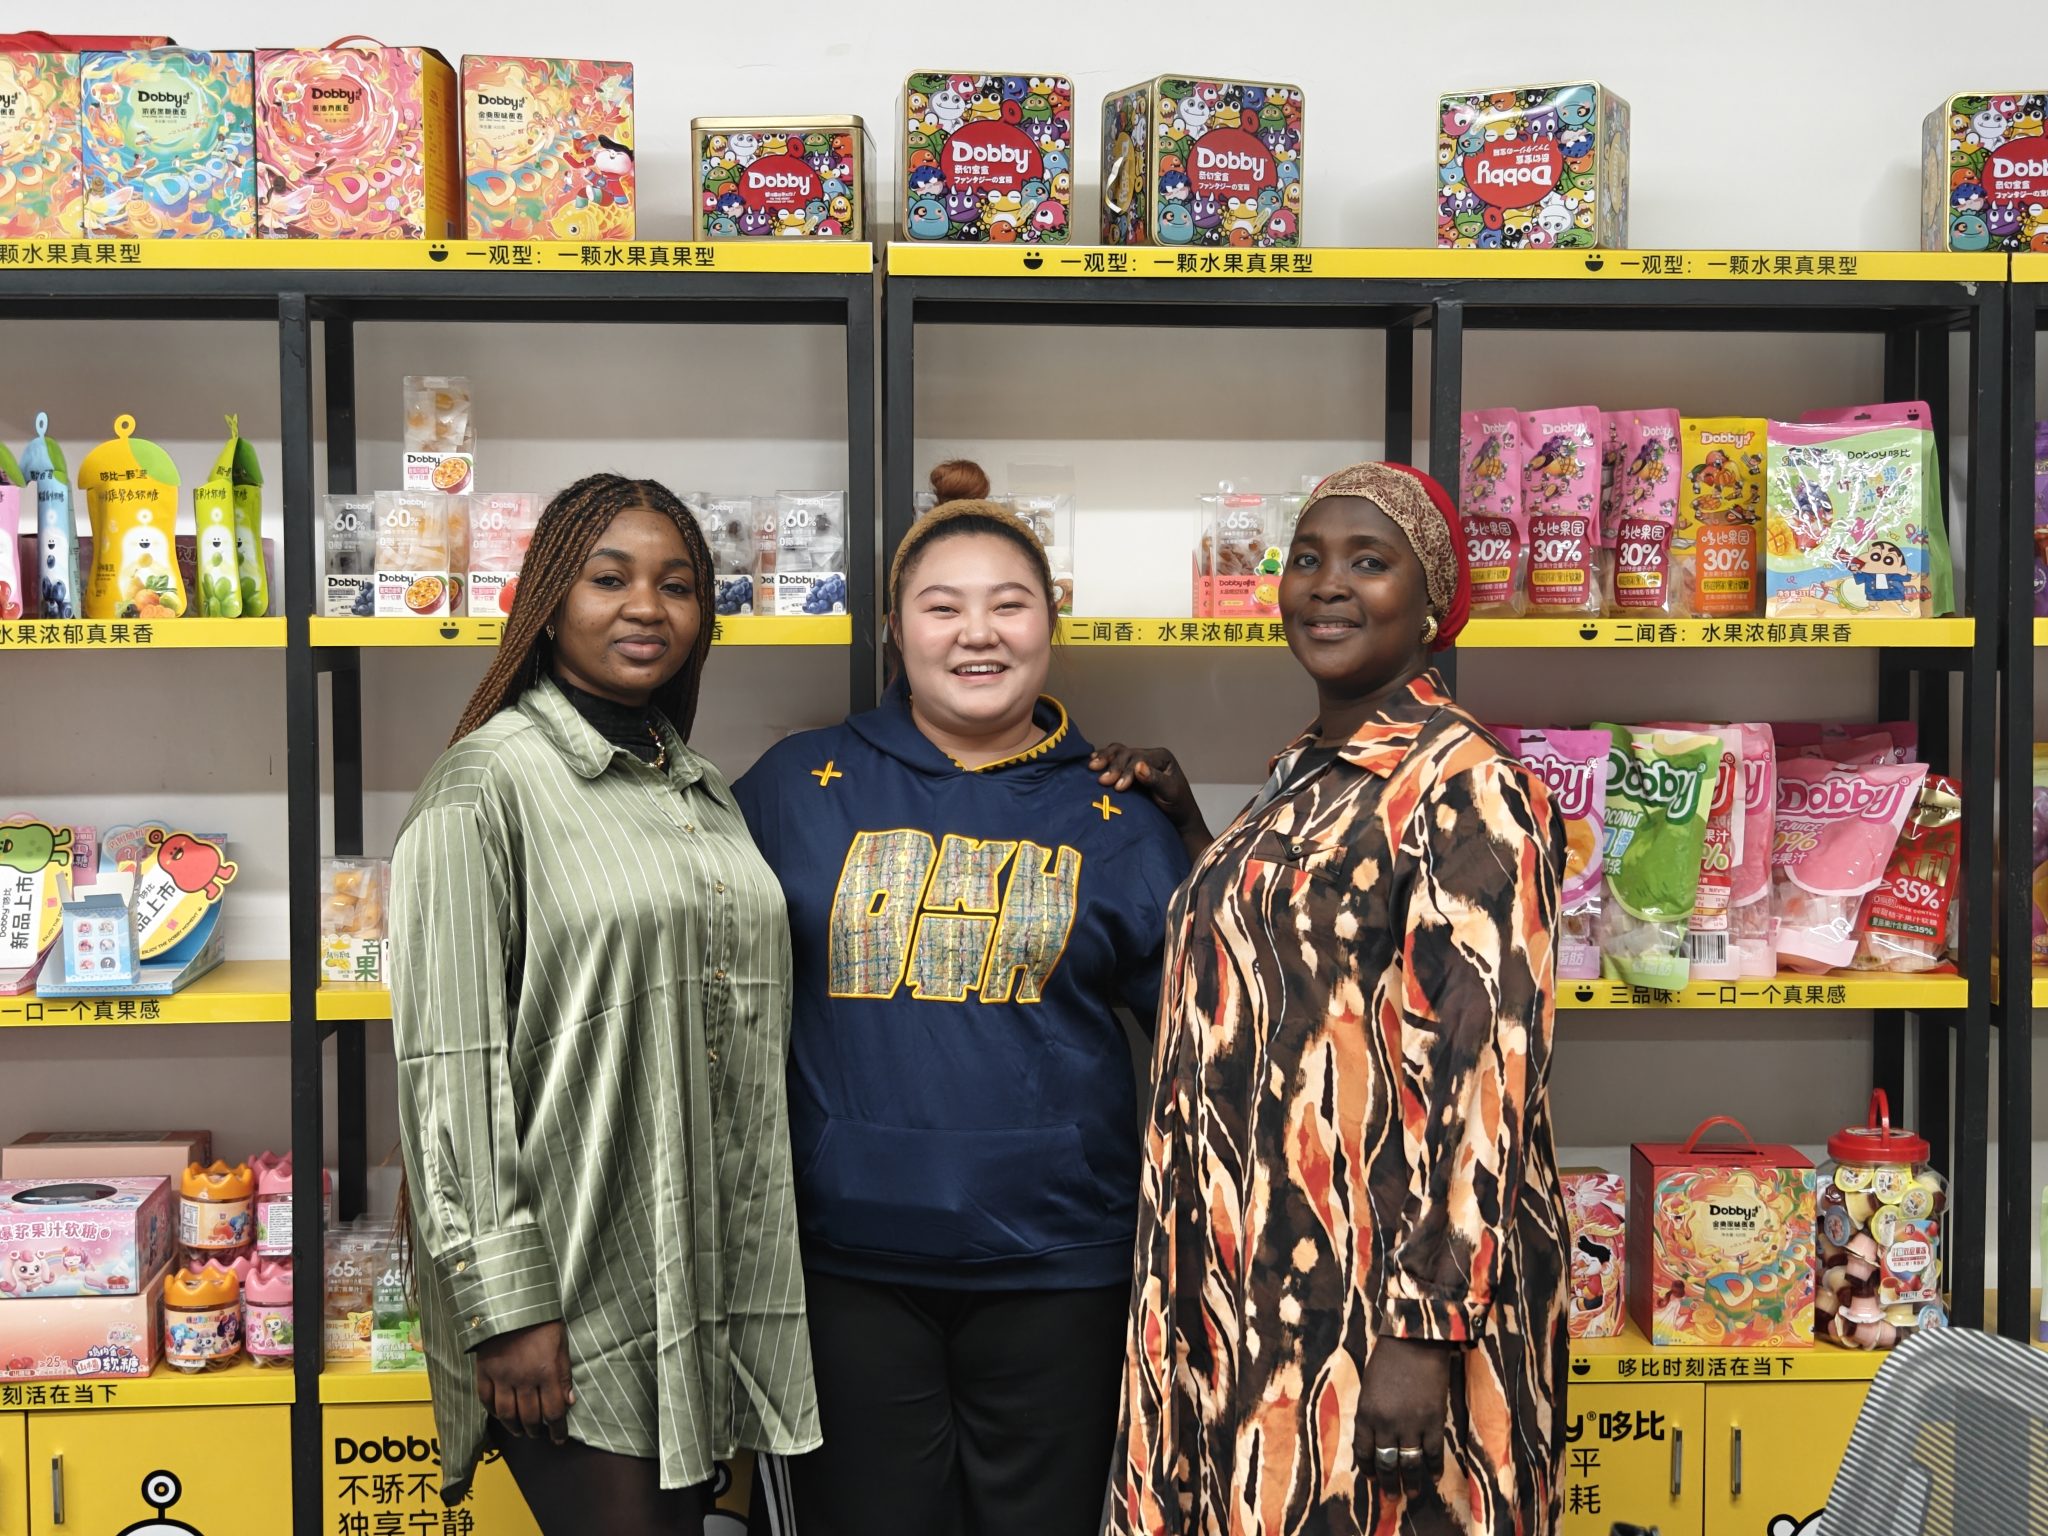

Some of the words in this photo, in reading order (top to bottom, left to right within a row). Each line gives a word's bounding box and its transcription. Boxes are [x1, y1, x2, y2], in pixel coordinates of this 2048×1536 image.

[137, 91, 183, 108] Dobby
[311, 87, 355, 104] Dobby
[478, 94, 519, 111] Dobby
[952, 140, 1030, 173] Dobby
[1196, 146, 1265, 181] Dobby
[748, 172, 811, 196] Dobby
[1476, 160, 1552, 187] Dobby
[557, 245, 716, 268] 一颗水果真果型
[1153, 252, 1313, 274] 一颗水果真果型
[1707, 255, 1858, 276] 一颗水果真果型
[1701, 431, 1745, 449] Dobby
[407, 454, 441, 467] Dobby
[1464, 520, 1512, 537] 哆比果园
[1532, 520, 1585, 537] 哆比果园
[1620, 524, 1665, 540] 哆比果园
[1701, 529, 1750, 546] 哆比果园
[1467, 538, 1511, 562] 30%
[1533, 539, 1582, 562] 30%
[1619, 543, 1662, 566] 30%
[1702, 548, 1750, 571] 30%
[328, 577, 365, 592] Dobby
[379, 573, 414, 587] Dobby
[472, 574, 507, 587] Dobby
[778, 574, 816, 588] Dobby
[1701, 623, 1853, 643] 水果浓郁真果香
[1777, 775, 1902, 824] Dobby
[10, 875, 34, 950] 新品上市
[1696, 984, 1846, 1004] 一口一个真果感
[2, 1000, 160, 1022] 一口一个真果感
[1709, 1204, 1751, 1221] Dobby
[102, 1356, 140, 1374] 软糖
[1618, 1357, 1795, 1378] 哆比时刻活在当下
[2, 1384, 118, 1406] 刻活在当下
[1599, 1410, 1665, 1442] 哆比
[339, 1474, 473, 1504] 不骄不
[338, 1505, 476, 1536] 独享宁静
